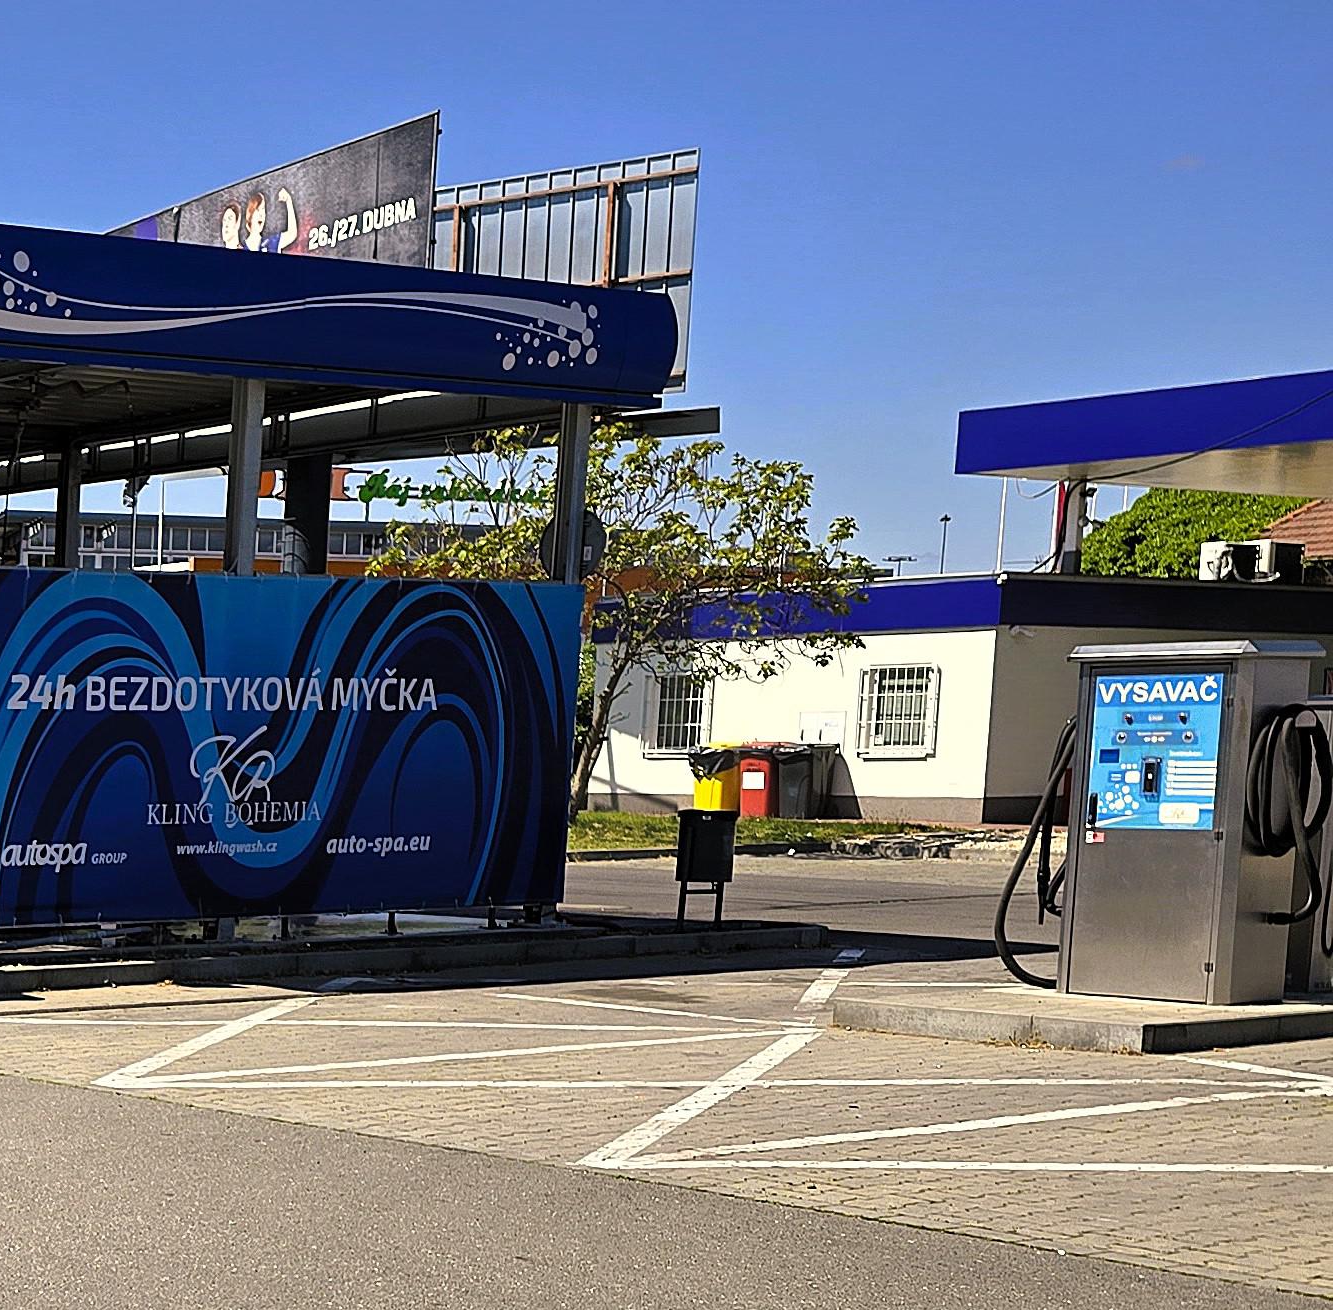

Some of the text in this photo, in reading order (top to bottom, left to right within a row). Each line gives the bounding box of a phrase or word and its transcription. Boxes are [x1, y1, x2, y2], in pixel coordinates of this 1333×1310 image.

[363, 198, 416, 233] DUBNA
[6, 668, 438, 712] 24h BEZDOTYKOVÁ MYČKA
[1098, 675, 1218, 704] VYSAVAČ
[146, 801, 322, 826] KLING BOHEMIA
[0, 840, 128, 873] autospa GROUP
[176, 840, 278, 856] www.klingwash.cz
[326, 834, 431, 857] auto-spa.eu
